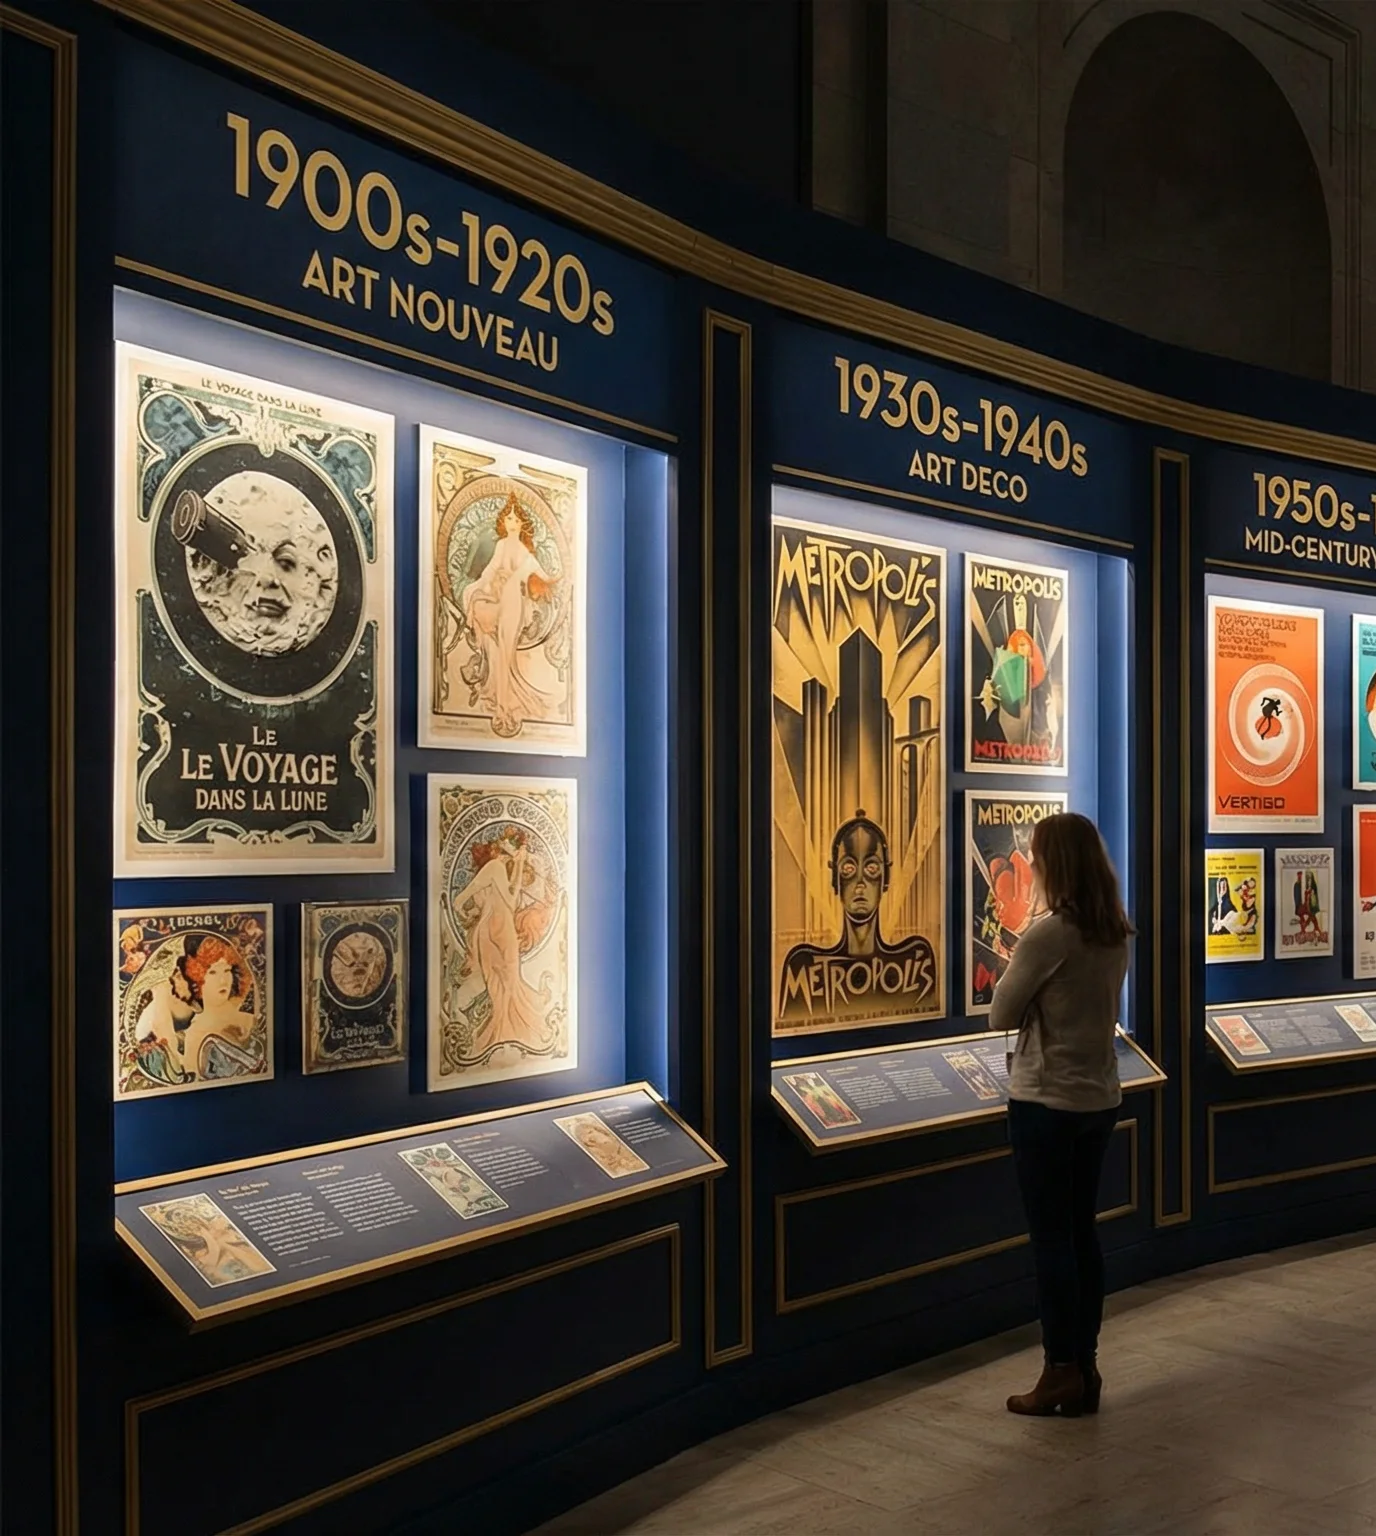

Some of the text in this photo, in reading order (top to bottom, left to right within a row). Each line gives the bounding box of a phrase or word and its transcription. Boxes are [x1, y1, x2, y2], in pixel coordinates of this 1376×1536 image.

[226, 111, 616, 337] 1900s-1920s
[302, 249, 559, 372] ART NOUVEAU
[835, 355, 1089, 477] 1930s-1940s
[908, 449, 1029, 503] ART DECO
[973, 565, 1063, 601] METROPOLIS
[252, 726, 278, 746] LE
[180, 742, 338, 786] LE VOYAGE
[195, 788, 328, 811] DANS LA LUNE
[1218, 795, 1285, 810] VERTIGO
[780, 950, 934, 1018] METROPOLIS
